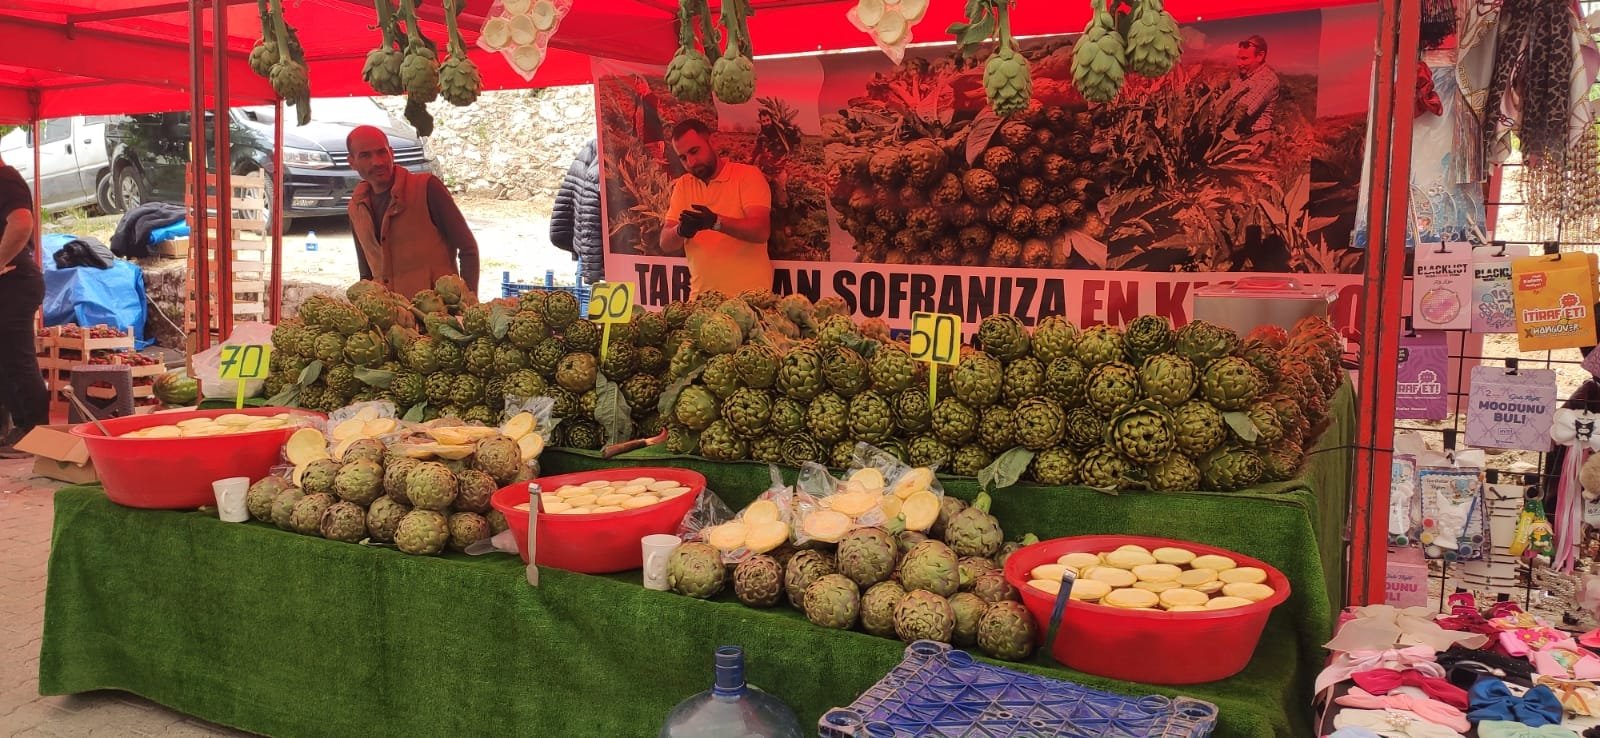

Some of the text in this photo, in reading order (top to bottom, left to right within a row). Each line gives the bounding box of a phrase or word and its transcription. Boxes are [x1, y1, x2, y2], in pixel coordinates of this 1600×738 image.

[1417, 263, 1468, 275] BLACKLIST
[588, 282, 630, 320] 50
[634, 263, 821, 306] TARAN
[832, 269, 1067, 327] SOFRANIZA
[1080, 279, 1139, 330] EN
[1523, 308, 1562, 322] İTİRAF
[1533, 323, 1580, 335] HANGOVER
[911, 313, 955, 362] 50
[220, 344, 264, 378] 70
[1478, 400, 1546, 415] MOODUNU
[1385, 582, 1418, 593] DUNU
